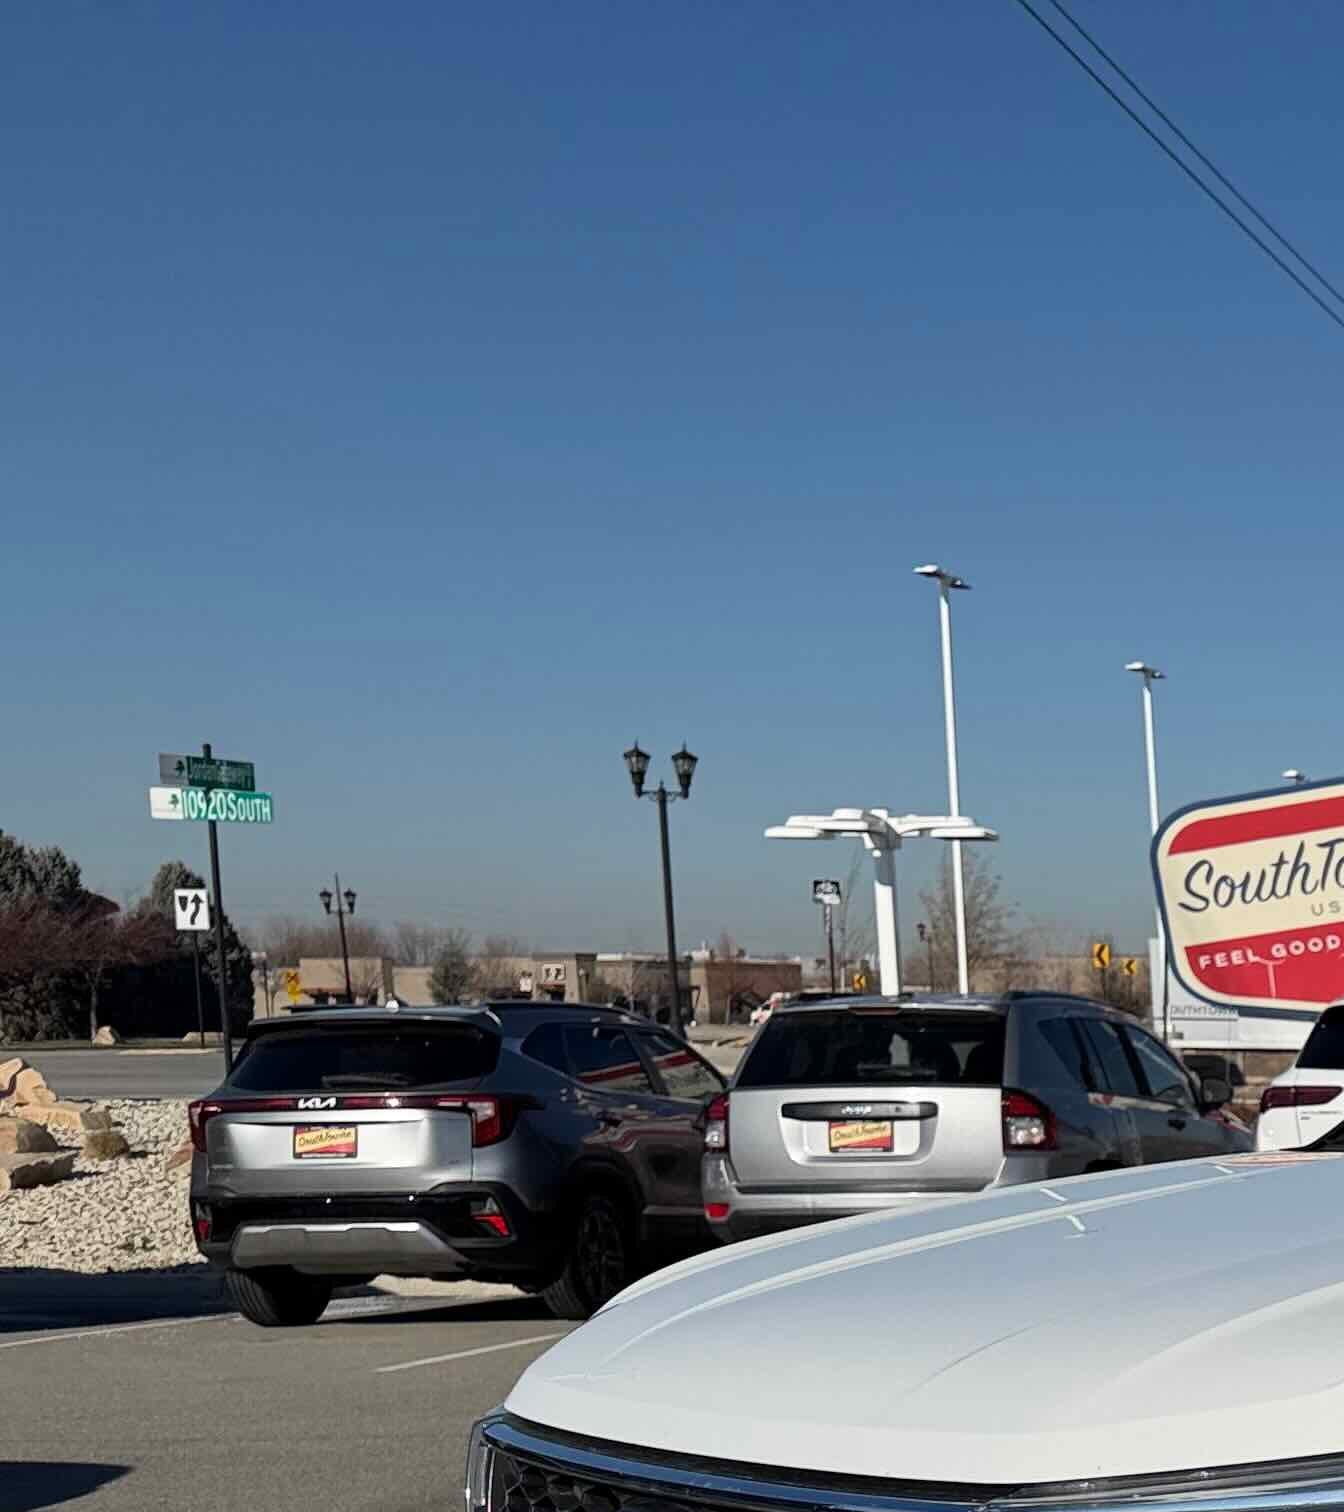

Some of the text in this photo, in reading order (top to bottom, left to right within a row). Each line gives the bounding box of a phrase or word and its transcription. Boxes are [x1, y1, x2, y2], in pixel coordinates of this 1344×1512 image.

[183, 790, 227, 819] 10920
[1199, 945, 1262, 971] FEEL
[1271, 933, 1342, 959] GOOD
[298, 1096, 337, 1109] KIA
